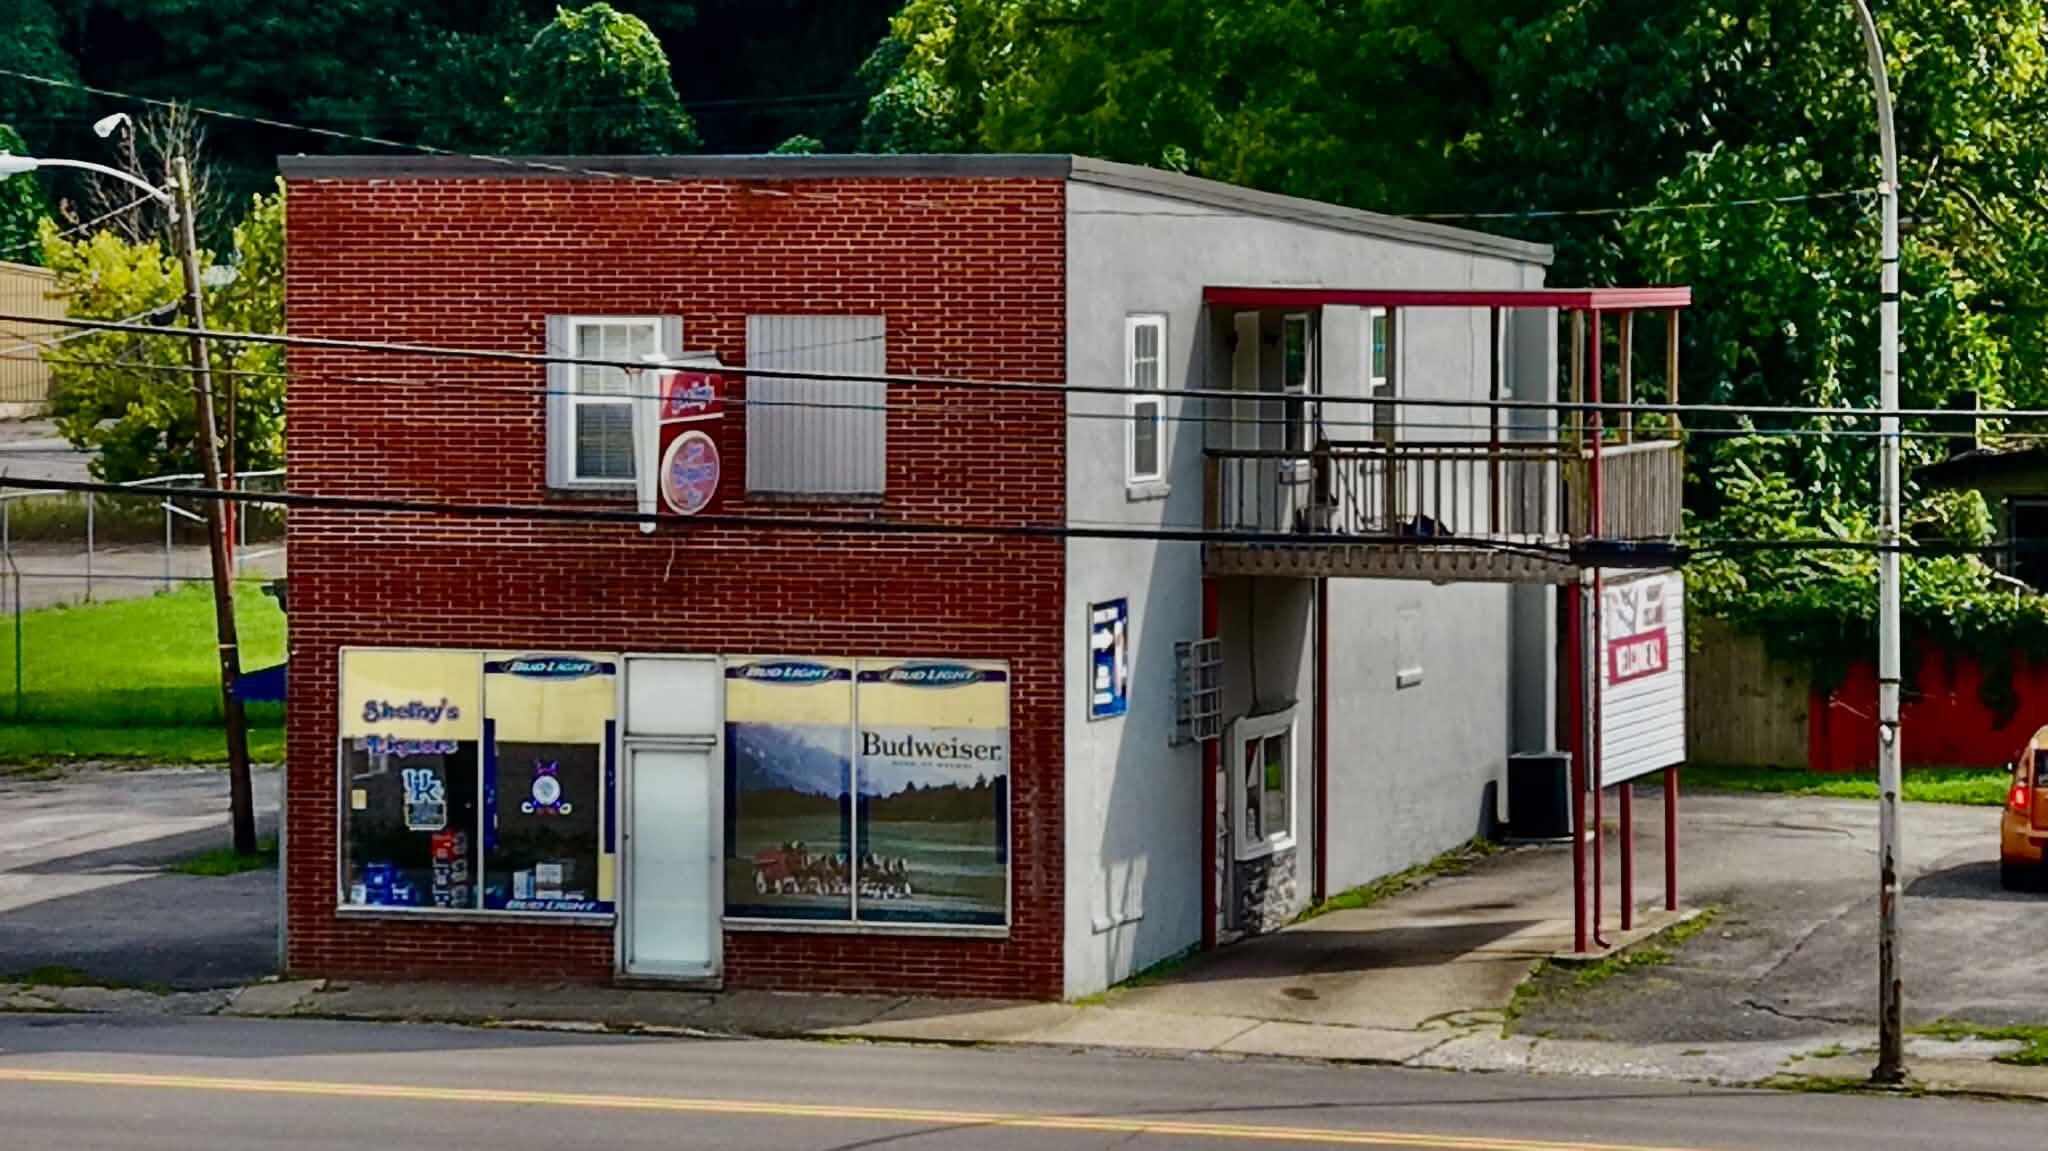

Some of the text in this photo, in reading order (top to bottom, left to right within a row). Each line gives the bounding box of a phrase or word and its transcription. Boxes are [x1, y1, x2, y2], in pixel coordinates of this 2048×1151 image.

[746, 667, 831, 678] BUD LIGHT
[890, 668, 975, 681] BUD LIGHT
[506, 900, 596, 911] BUD LIGHT
